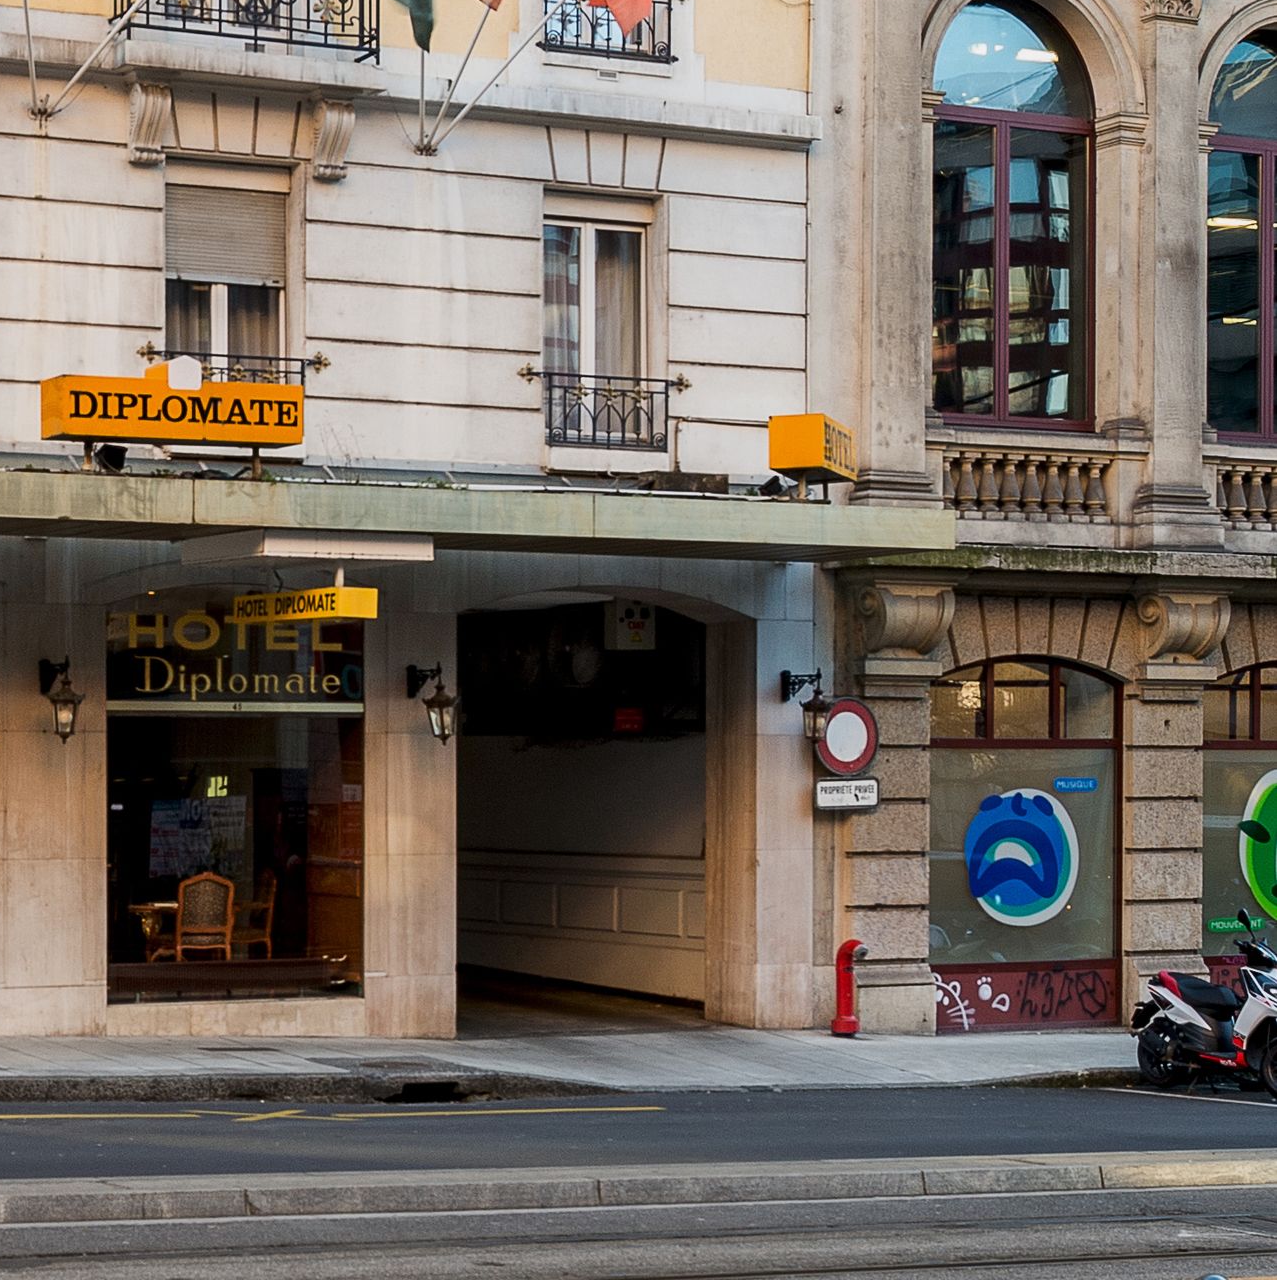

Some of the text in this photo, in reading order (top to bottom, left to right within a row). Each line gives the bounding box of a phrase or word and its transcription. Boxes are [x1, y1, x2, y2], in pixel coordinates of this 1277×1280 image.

[69, 390, 299, 427] DIPLOMATE
[823, 421, 856, 474] HOTEL
[236, 592, 336, 618] HOTEL DIPLOMATE
[134, 654, 341, 701] Diplomate
[1056, 780, 1095, 789] MUSIQUE
